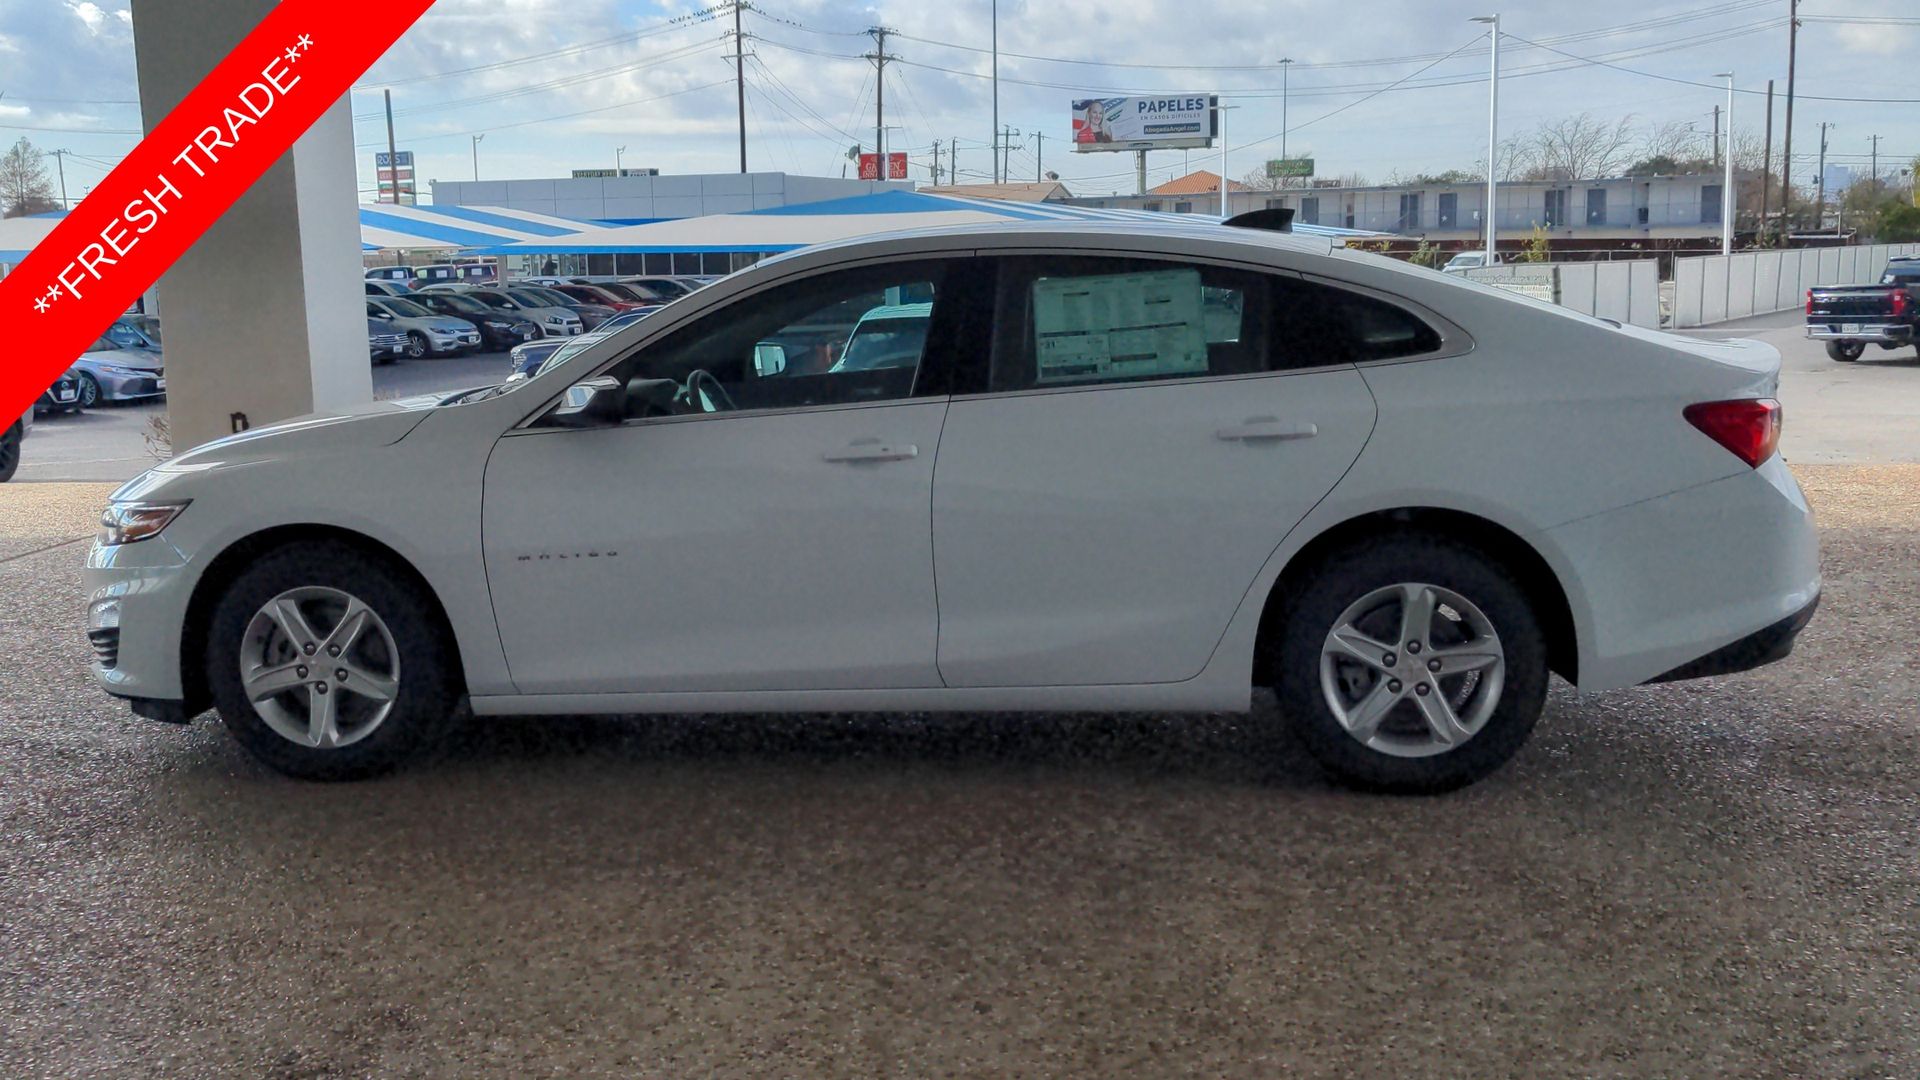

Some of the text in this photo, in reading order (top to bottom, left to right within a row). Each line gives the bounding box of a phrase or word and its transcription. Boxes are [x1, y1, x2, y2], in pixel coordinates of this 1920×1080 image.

[1138, 98, 1204, 113] PAPELES
[377, 154, 401, 165] ROS
[865, 161, 901, 171] GAEN
